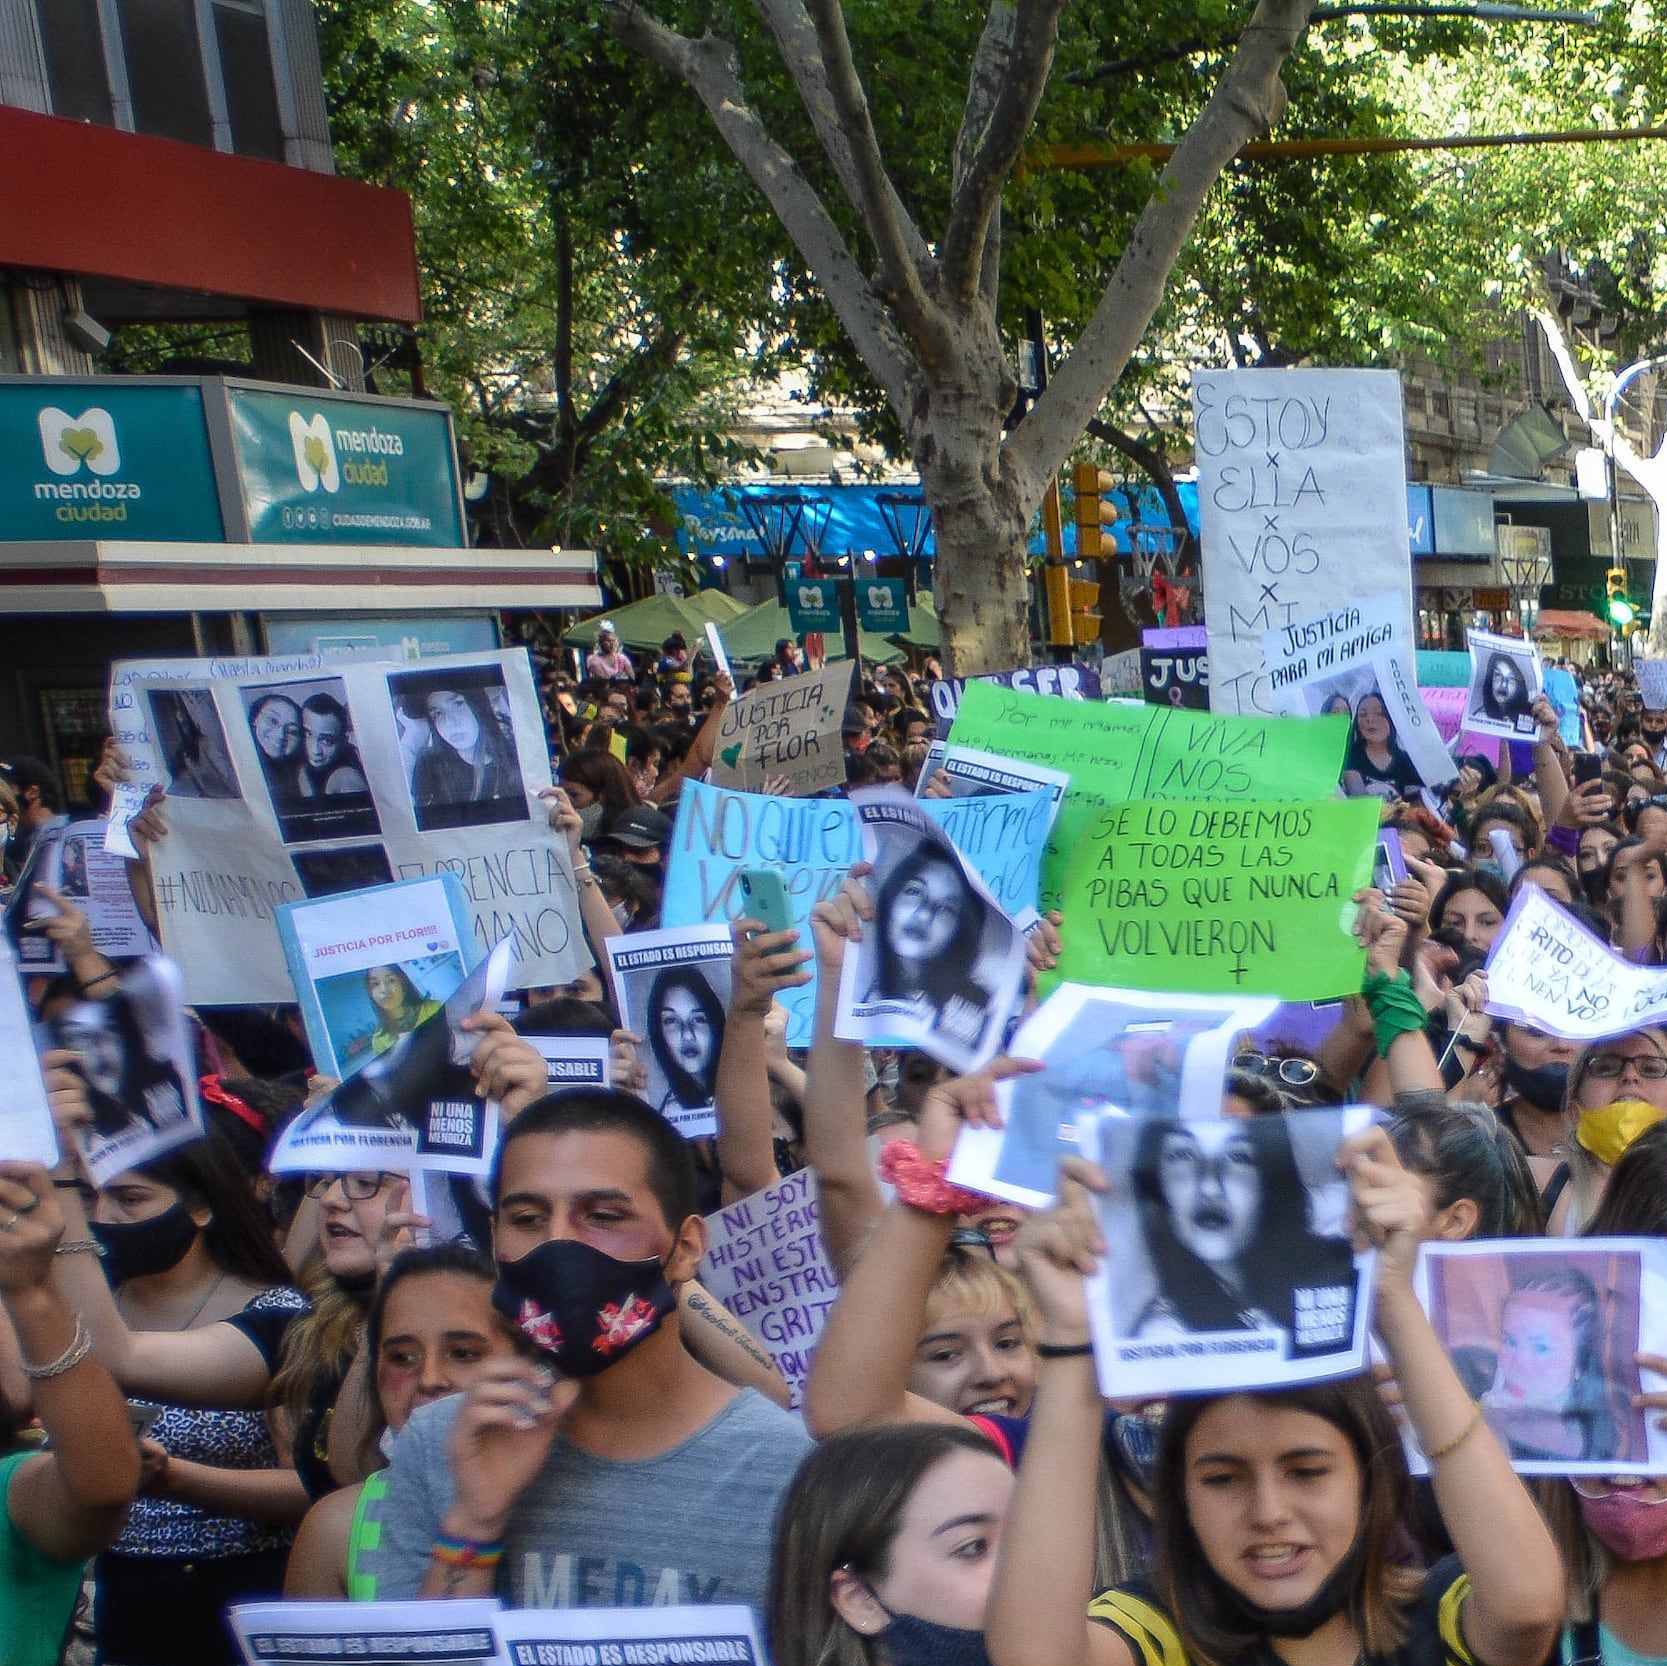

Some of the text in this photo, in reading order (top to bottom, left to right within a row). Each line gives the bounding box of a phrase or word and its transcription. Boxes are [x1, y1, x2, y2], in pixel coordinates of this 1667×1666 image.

[1196, 383, 1330, 456] ESTOY
[336, 429, 403, 456] mendoza
[344, 461, 389, 487] ciudad
[34, 480, 141, 500] mendoza
[1213, 465, 1326, 513] ELLA
[56, 503, 127, 522] ciudad
[1228, 532, 1319, 575] VOS
[1272, 658, 1307, 690] PARA
[721, 682, 824, 737] JUSTICIA
[755, 717, 791, 743] POR
[754, 729, 821, 770] FLOR
[956, 763, 990, 782] ESTADO
[1162, 759, 1251, 794] NOS
[686, 789, 749, 861] NO
[1091, 807, 1313, 840] SE LO DEBEMOS
[1098, 842, 1294, 871] A TODAS LAS
[1085, 871, 1340, 909] PIBAS QUE NUNCA
[313, 941, 366, 960] JUSTICIA
[369, 933, 393, 949] POR
[1097, 917, 1278, 957] VOLVIERON
[617, 954, 628, 967] EL
[628, 948, 661, 965] ESTADO
[662, 946, 675, 961] ES
[430, 1116, 474, 1133] MENOS
[431, 1101, 473, 1119] NI UNA
[427, 1132, 472, 1147] MENDOZA
[722, 1172, 809, 1237] NI SOY
[731, 1258, 764, 1288] NI
[517, 1641, 748, 1666] EL ESTADO ES RESPONSABLE
